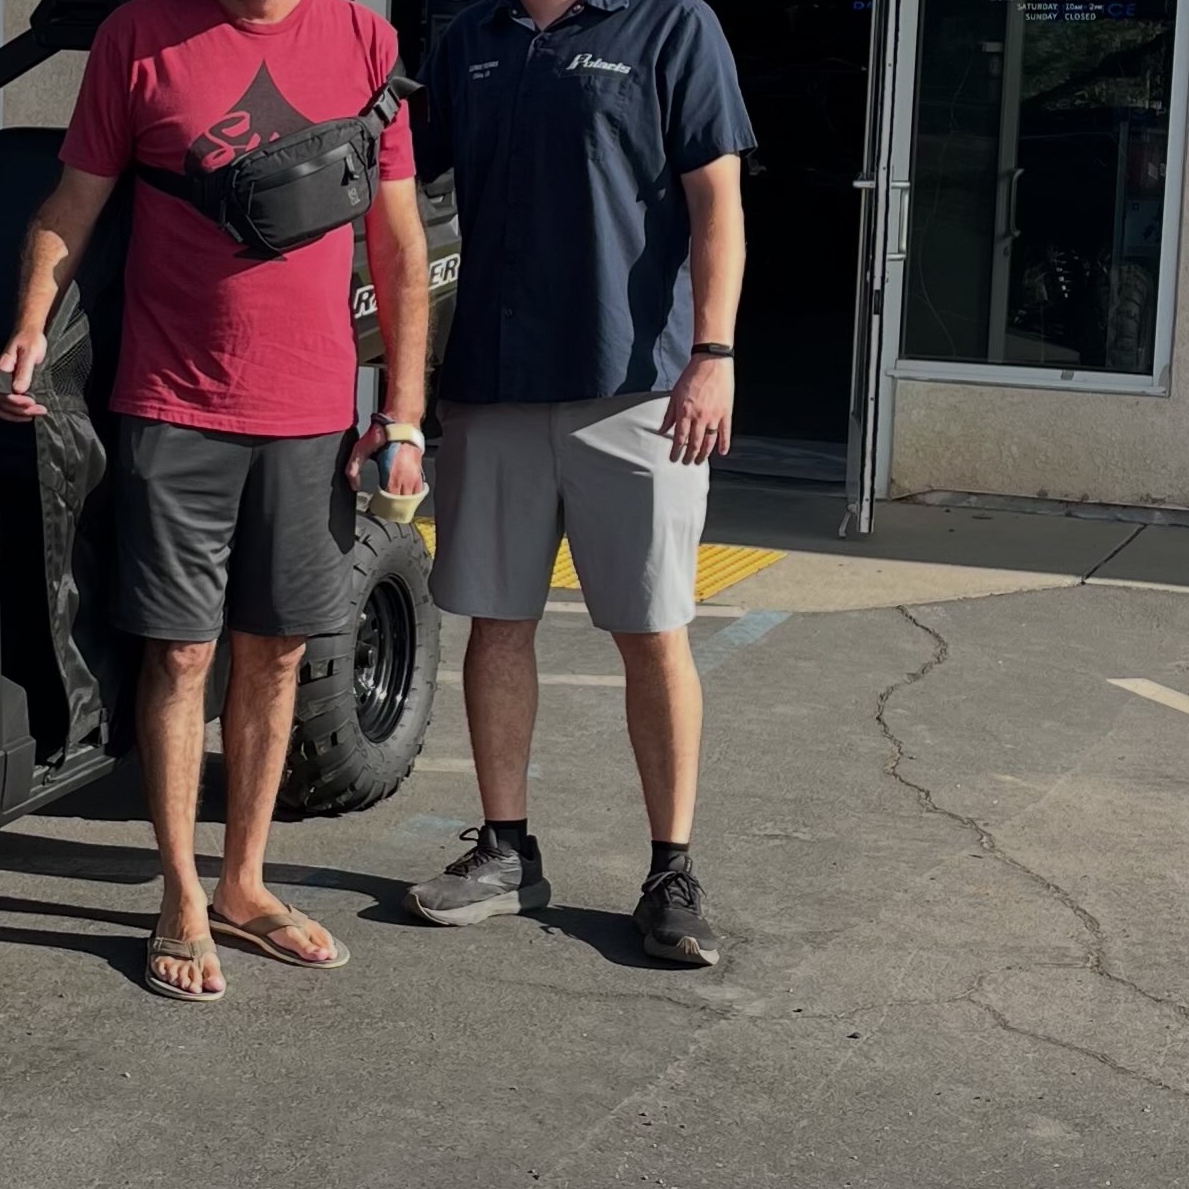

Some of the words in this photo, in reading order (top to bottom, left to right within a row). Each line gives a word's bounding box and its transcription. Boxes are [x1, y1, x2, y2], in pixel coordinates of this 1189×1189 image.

[1017, 2, 1058, 11] SATURDAY
[1025, 12, 1057, 21] SUNDAY
[1064, 12, 1097, 21] CLOSED
[566, 53, 631, 74] Polaris
